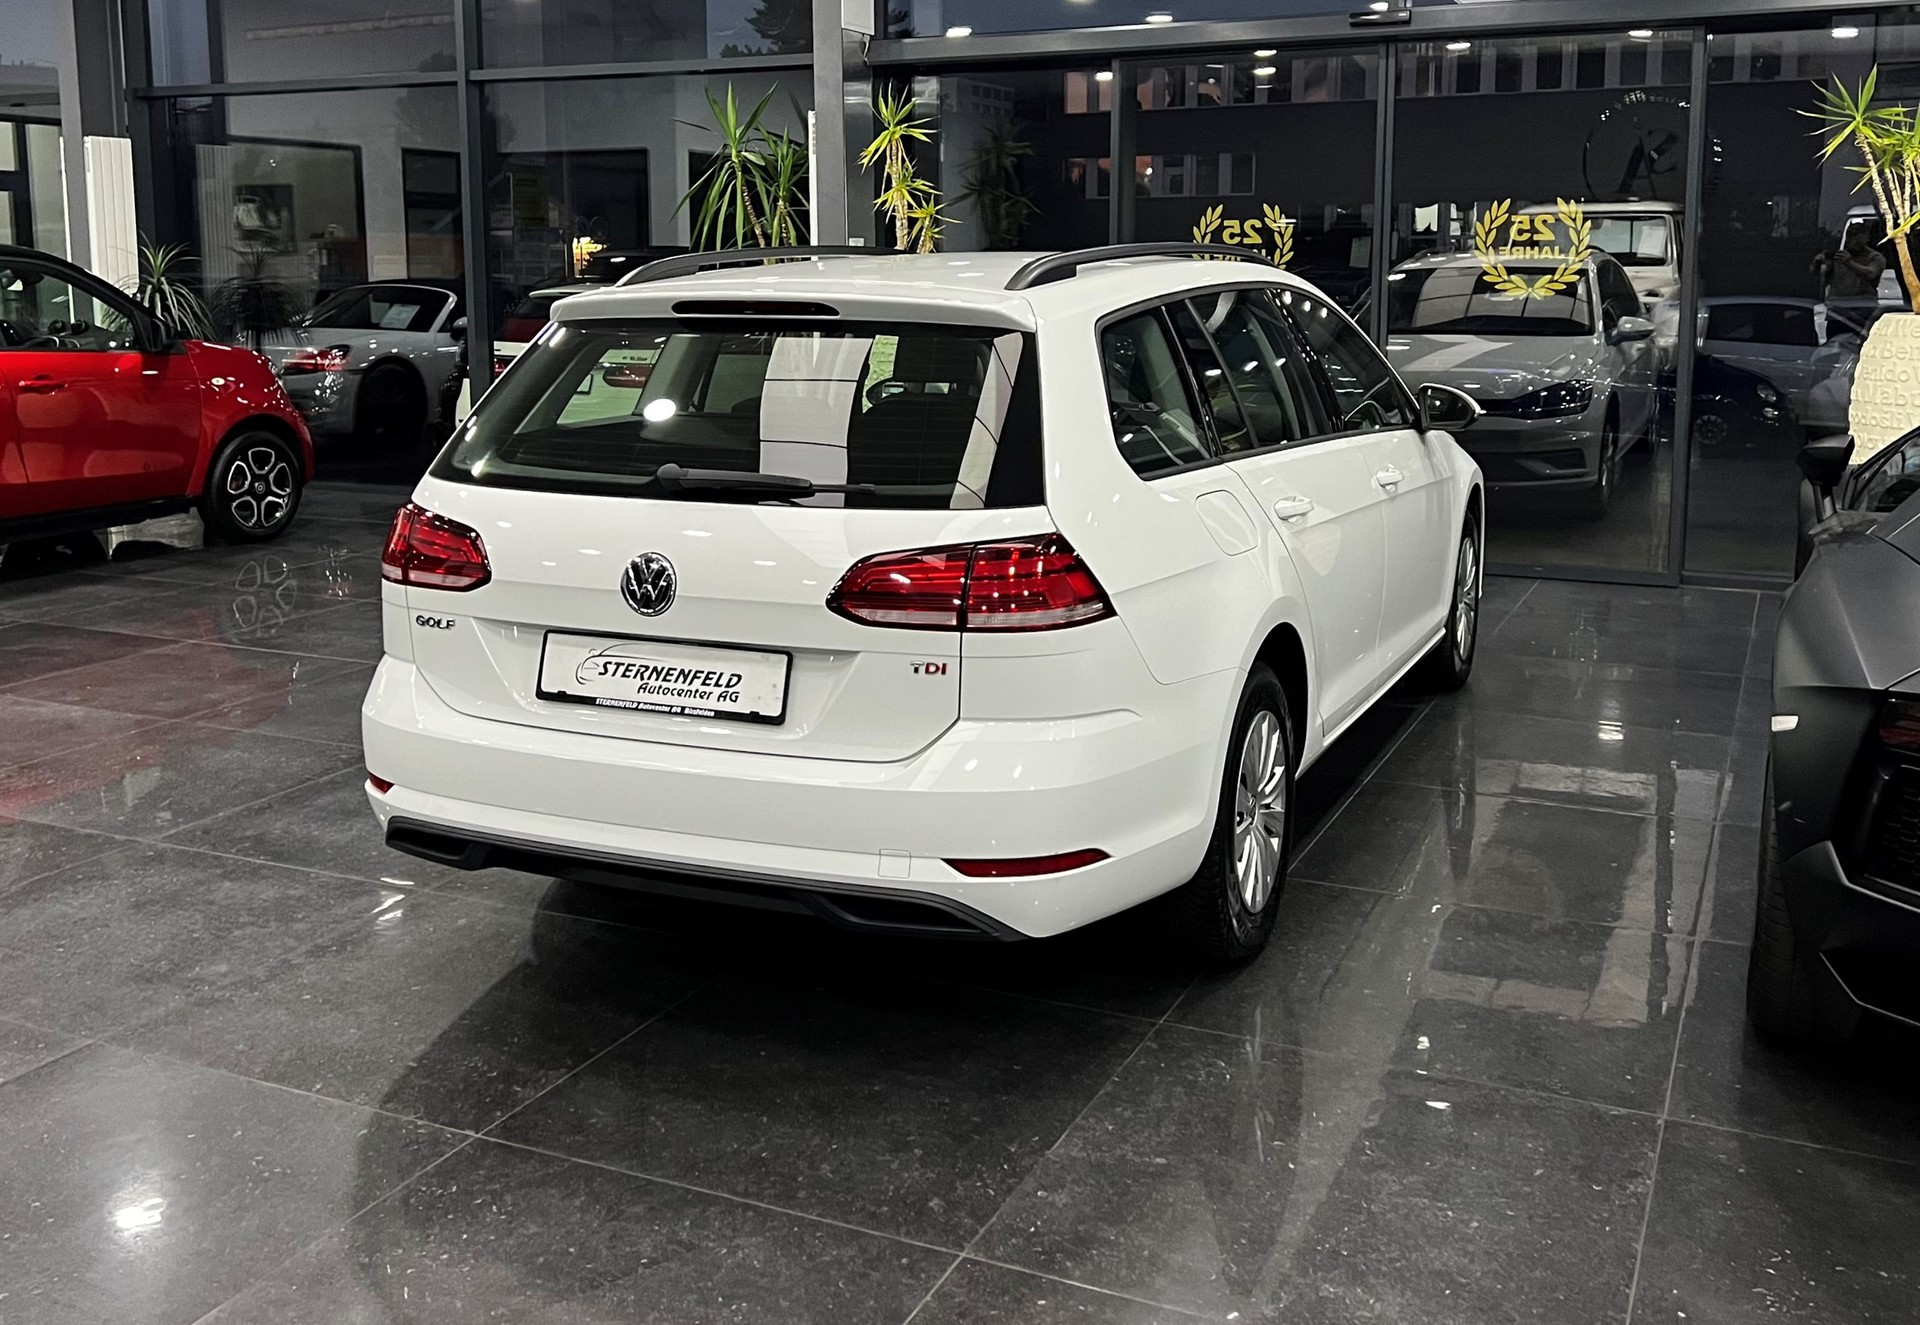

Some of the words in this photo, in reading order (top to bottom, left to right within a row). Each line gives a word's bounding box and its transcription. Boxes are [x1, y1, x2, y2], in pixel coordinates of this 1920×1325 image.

[415, 614, 456, 630] GOLF
[598, 661, 743, 689] STERNENFELD
[909, 660, 948, 676] TDI
[637, 682, 714, 701] Autocenter
[716, 690, 741, 703] AG
[595, 697, 638, 709] STERNENFELD
[638, 702, 671, 713] Autocenter
[671, 705, 682, 714] AG
